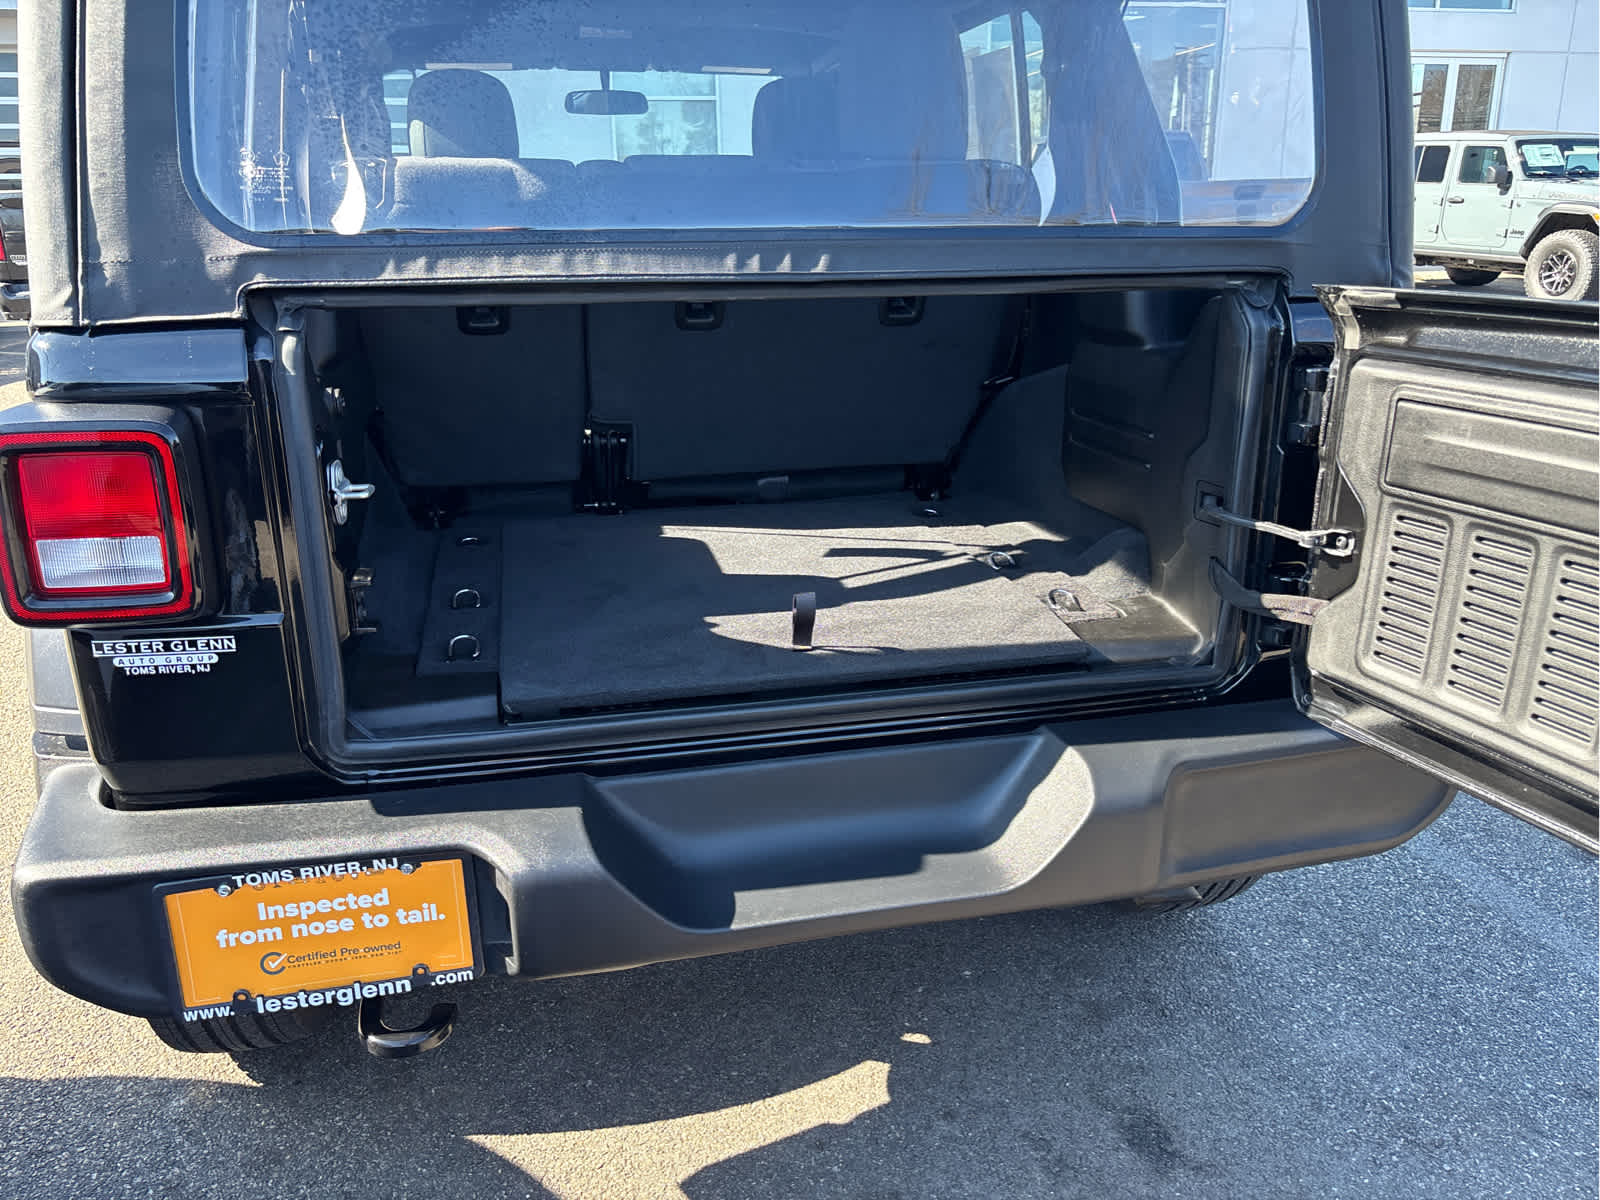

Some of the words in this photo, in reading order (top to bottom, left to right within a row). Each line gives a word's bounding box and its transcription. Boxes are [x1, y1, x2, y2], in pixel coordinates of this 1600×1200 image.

[92, 641, 164, 656] LESTER
[170, 638, 236, 652] GLENN
[118, 657, 156, 666] AUTO
[164, 655, 214, 664] GROUP
[124, 666, 156, 676] TOMS
[159, 664, 195, 675] RIVER,
[197, 664, 210, 673] NJ
[232, 869, 294, 888] TOMS
[300, 861, 367, 880] RIVER,
[373, 857, 398, 871] NJ
[257, 888, 390, 920] Inspected
[216, 926, 283, 948] from
[291, 916, 355, 938] nose
[361, 910, 389, 929] to
[396, 903, 446, 925] tail.
[287, 950, 337, 964] Certified
[183, 1006, 235, 1023] www.
[256, 979, 412, 1014] lesterglenn
[431, 968, 474, 987] .com
